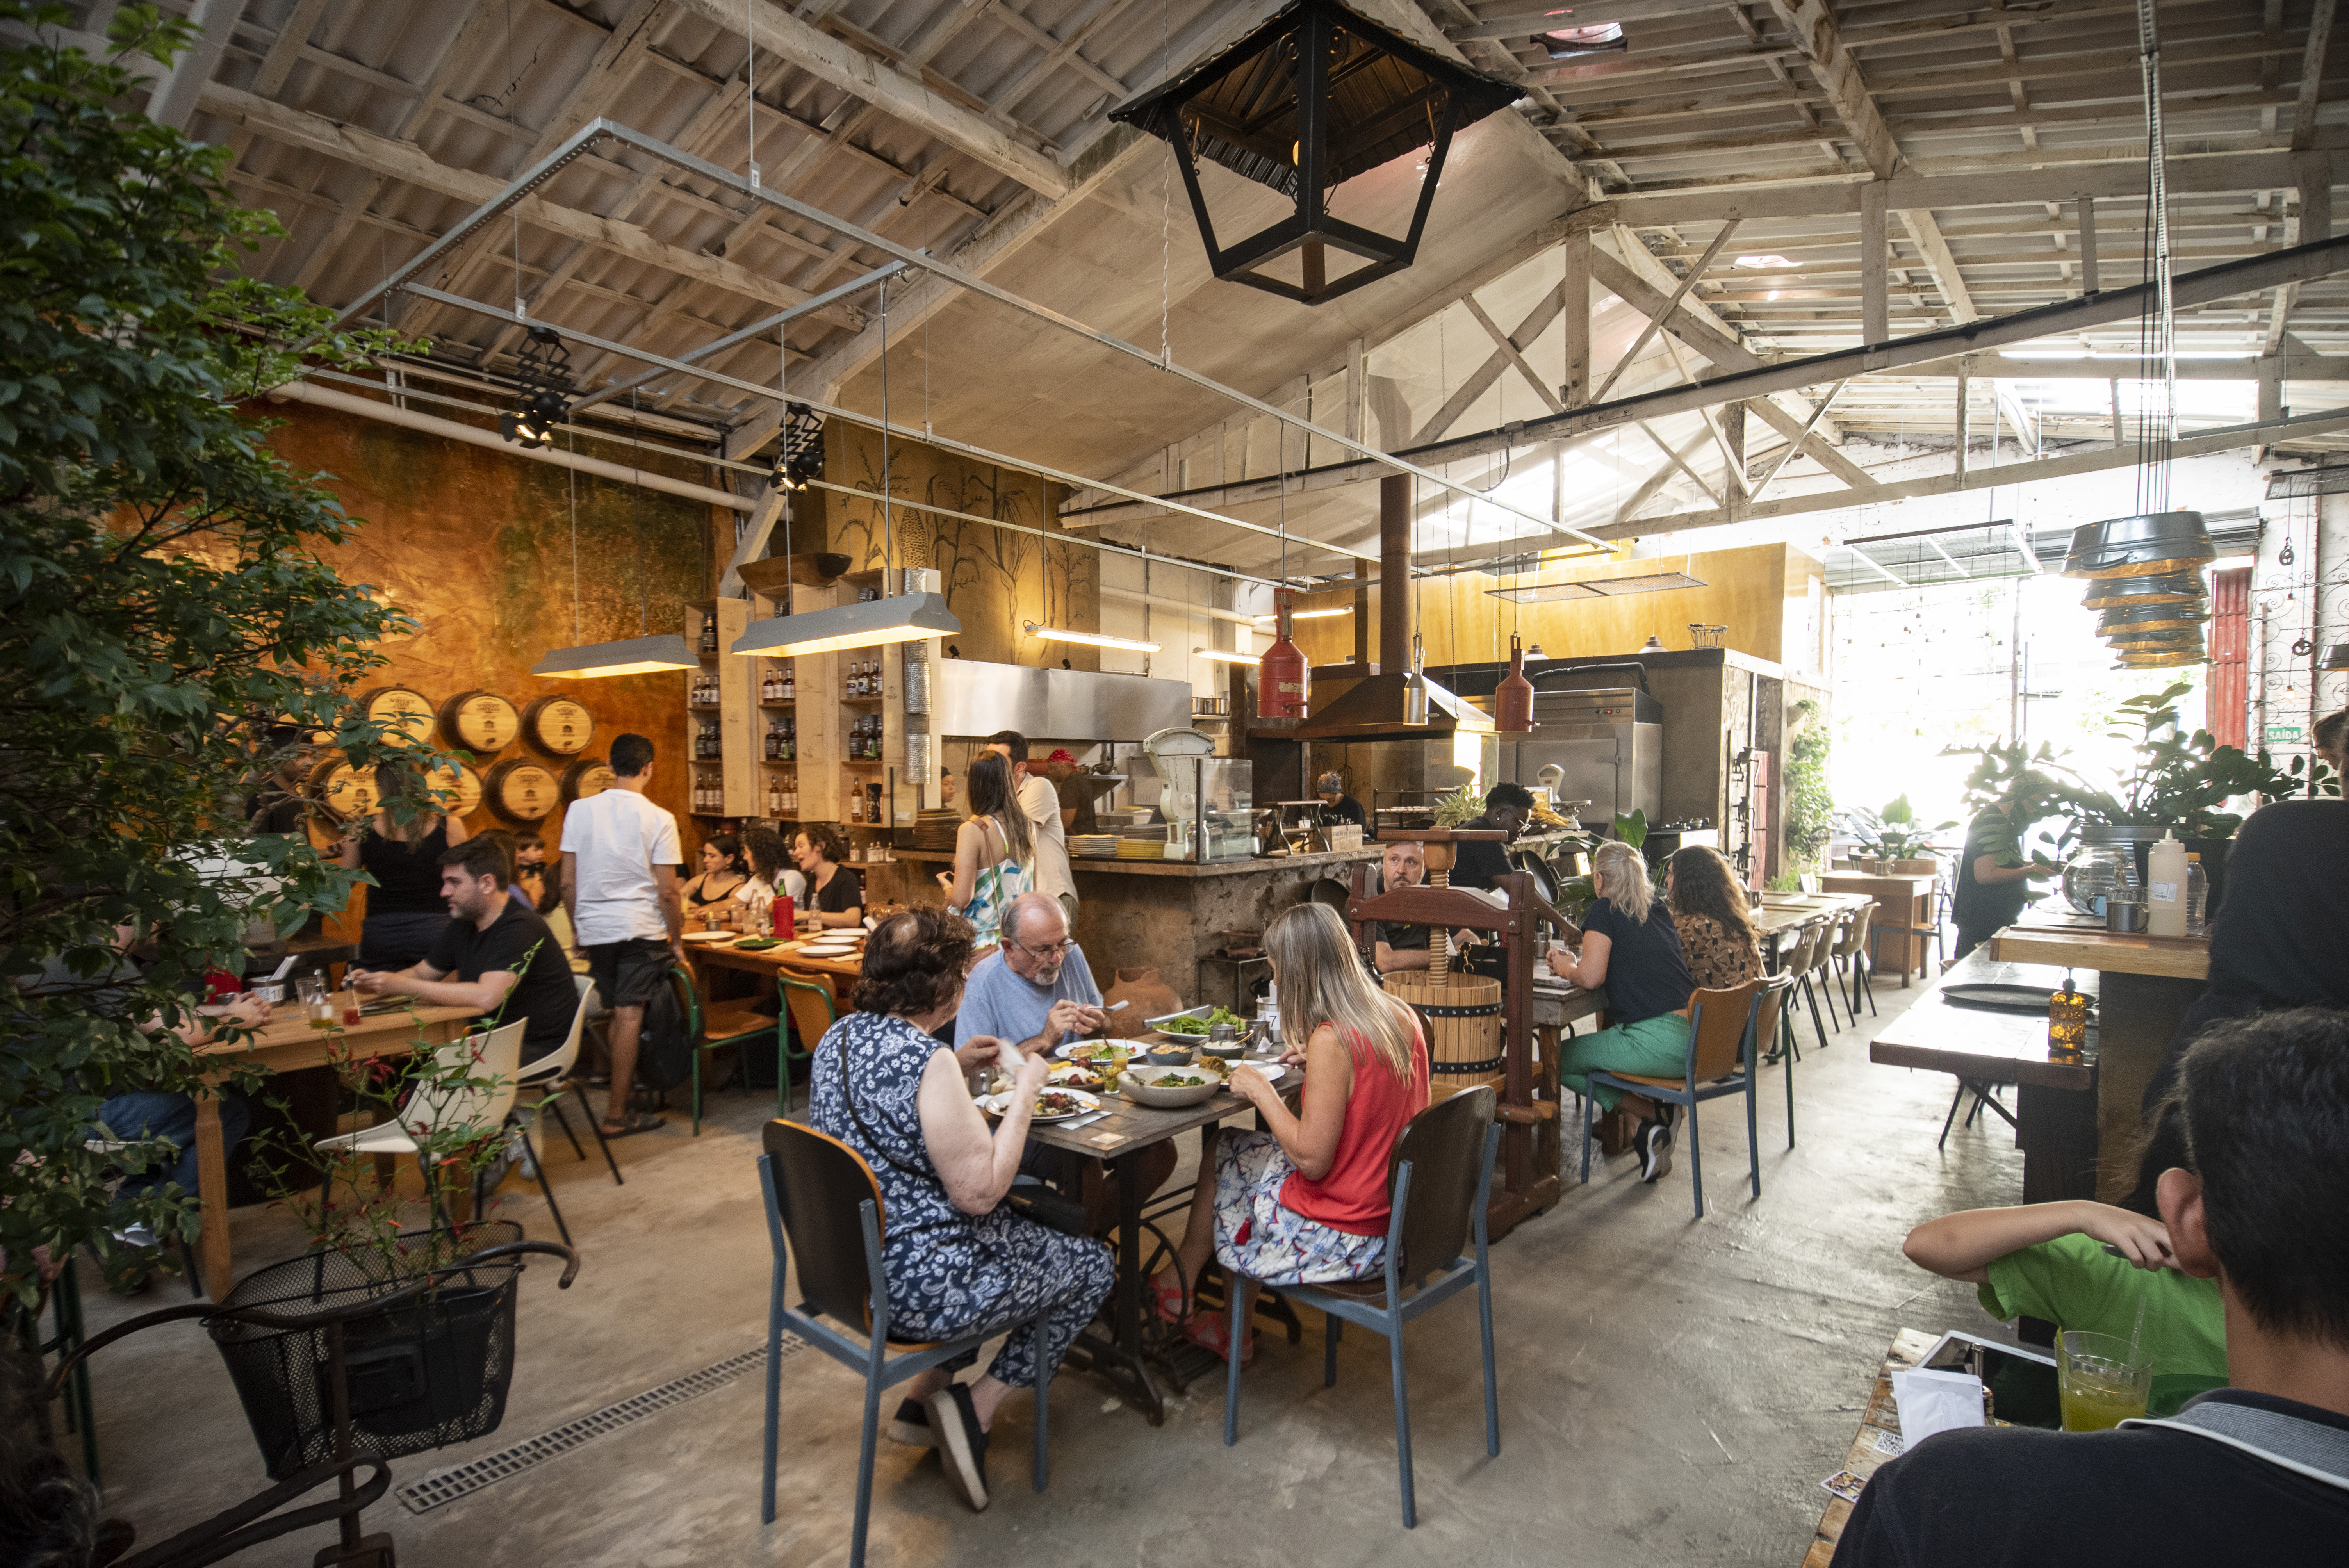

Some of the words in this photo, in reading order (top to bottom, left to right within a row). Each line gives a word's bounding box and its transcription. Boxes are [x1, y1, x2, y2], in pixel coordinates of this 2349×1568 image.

[2268, 729, 2299, 740] SAÍDA
[271, 988, 283, 1000] 10
[1269, 1016, 1277, 1027] 7
